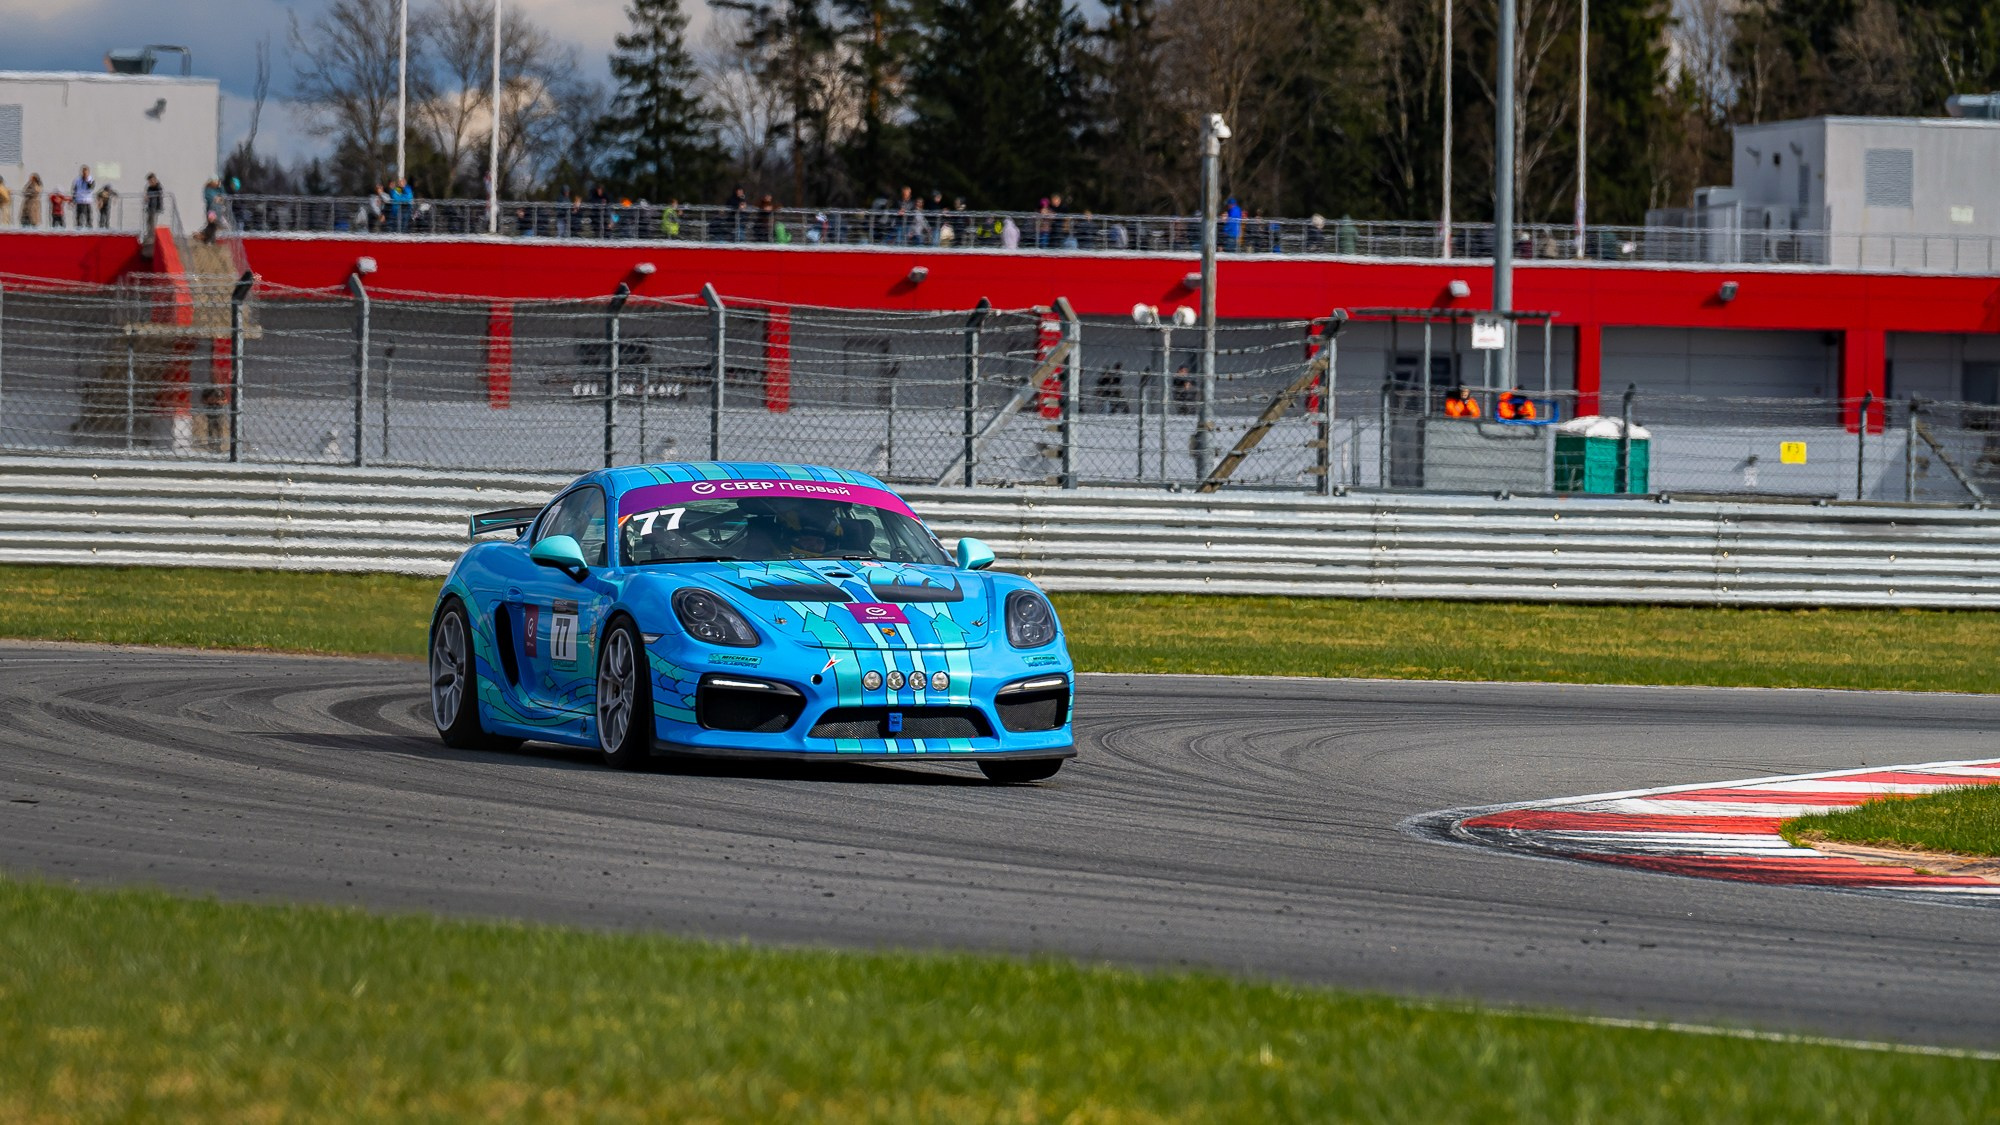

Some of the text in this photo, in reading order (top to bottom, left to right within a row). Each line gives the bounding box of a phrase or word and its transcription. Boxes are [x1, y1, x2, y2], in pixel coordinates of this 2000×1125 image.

[720, 482, 851, 496] СБЕР Первый
[633, 507, 686, 536] 77
[555, 617, 571, 657] 77
